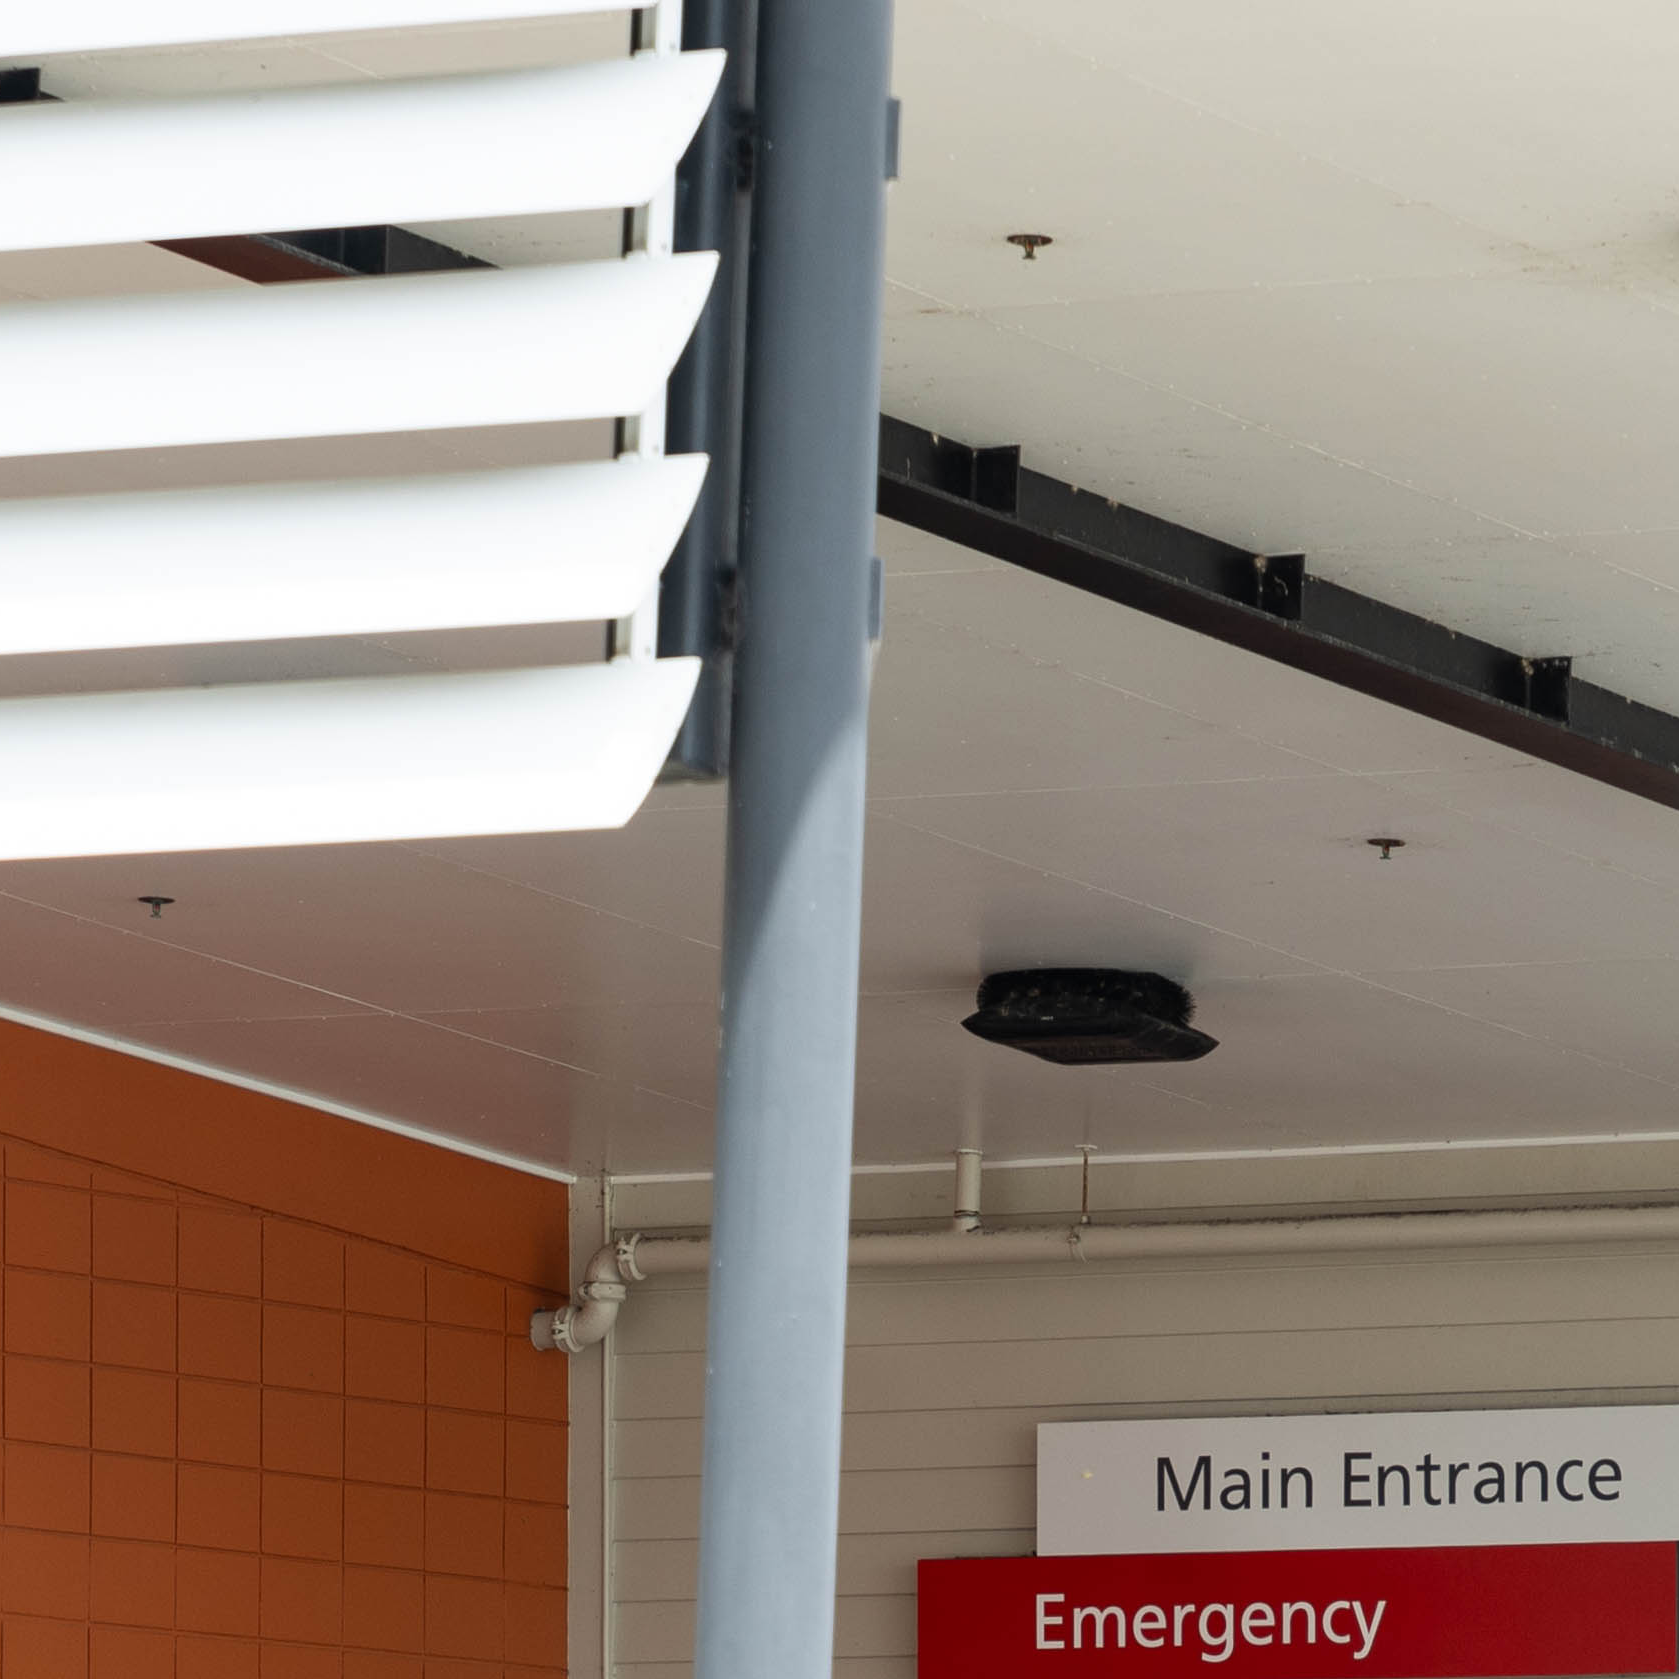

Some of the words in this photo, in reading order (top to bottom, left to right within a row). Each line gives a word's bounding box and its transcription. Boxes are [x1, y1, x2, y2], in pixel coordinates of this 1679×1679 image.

[1158, 1452, 1312, 1511] Main
[1344, 1452, 1621, 1507] Entrance
[1037, 1594, 1386, 1662] Emergency
